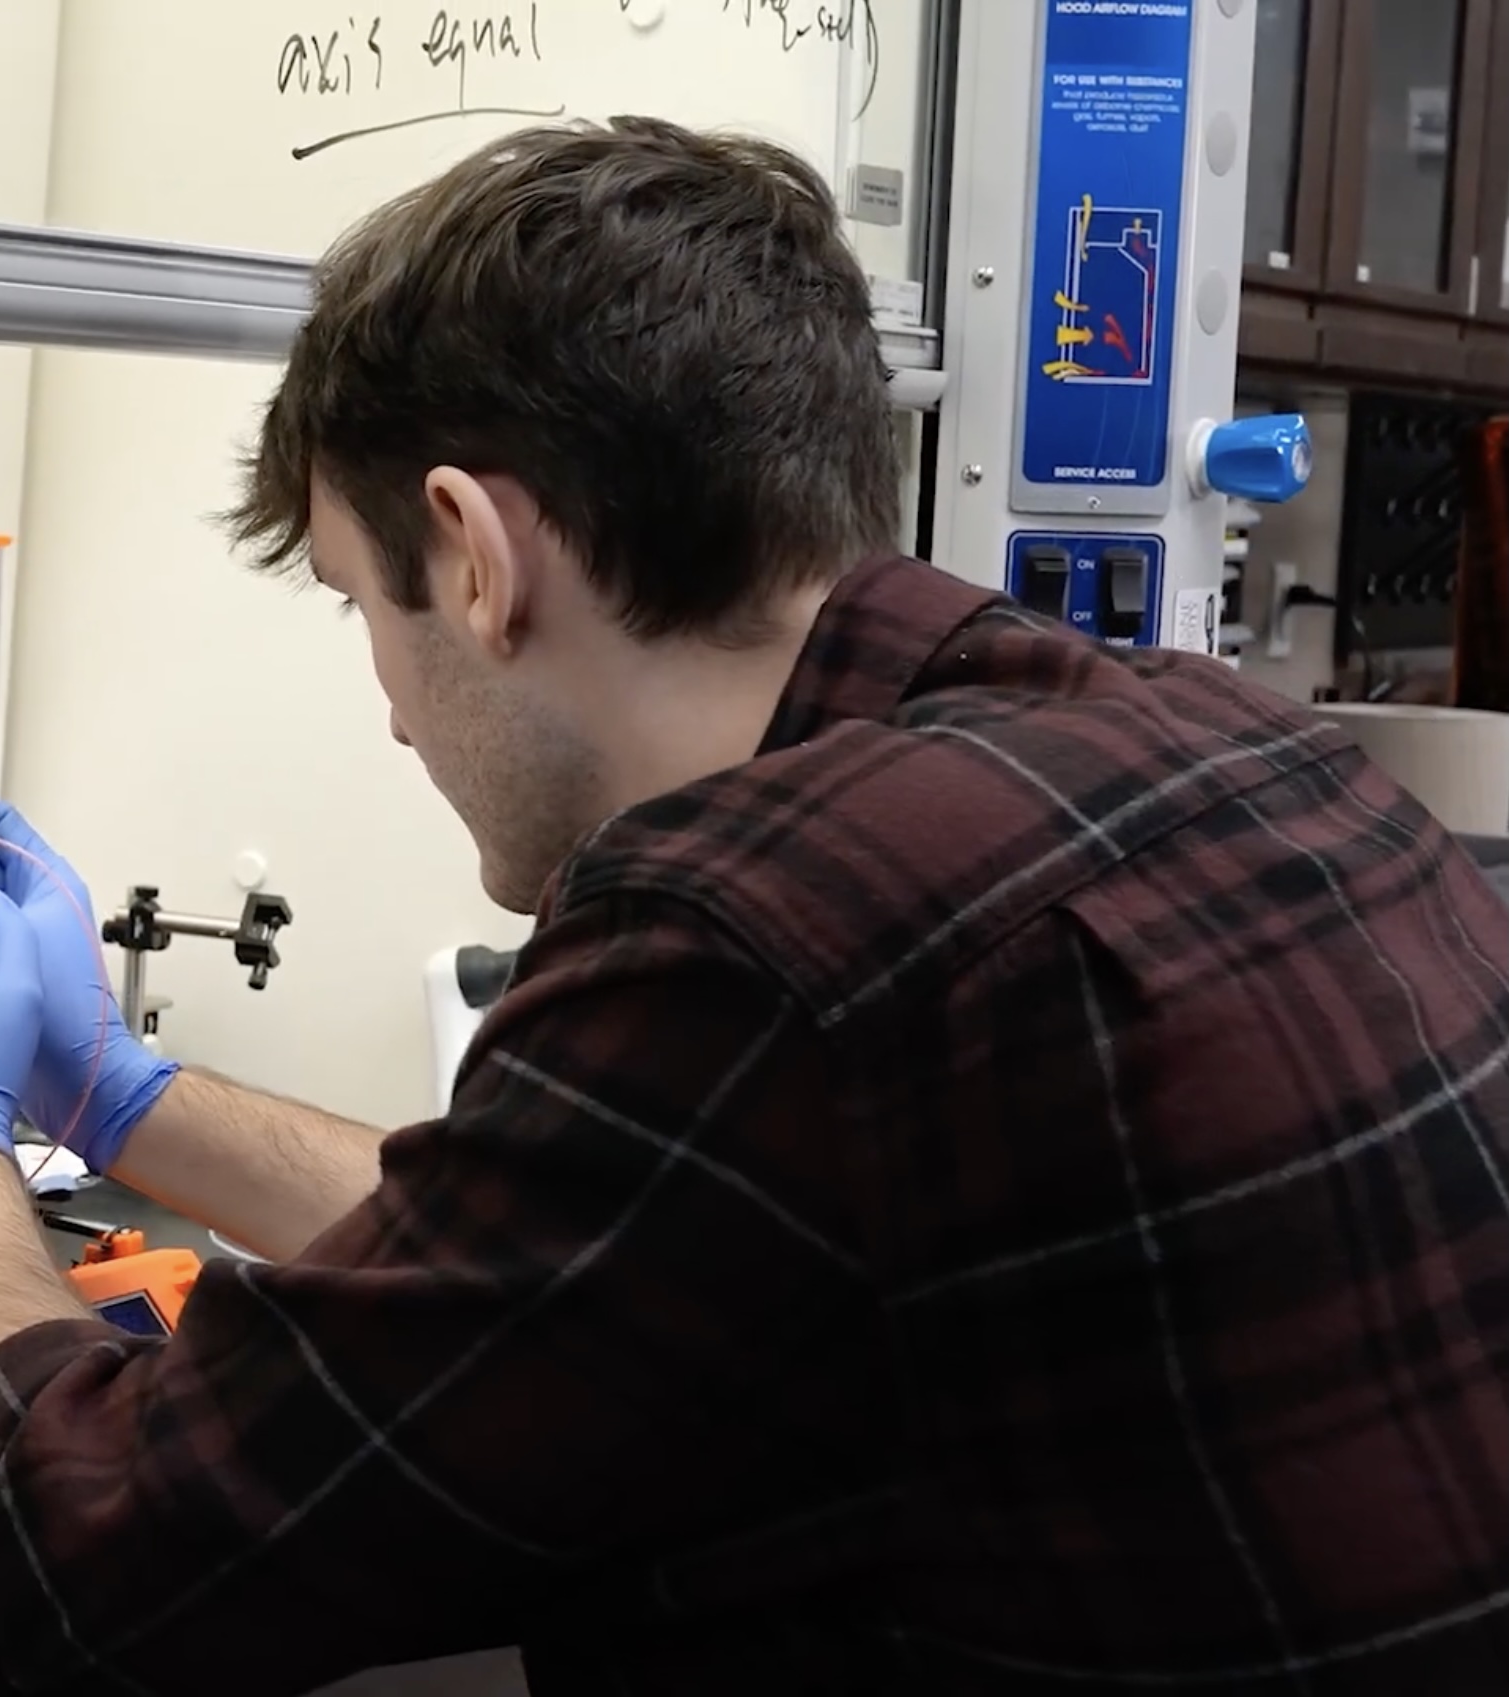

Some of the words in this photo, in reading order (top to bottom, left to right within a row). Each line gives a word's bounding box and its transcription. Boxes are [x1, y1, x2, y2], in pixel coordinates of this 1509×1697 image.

[1055, 2, 1092, 14] HOOD
[277, 17, 382, 95] axis
[422, 2, 541, 112] equal
[1054, 466, 1095, 479] SERVICE
[1097, 467, 1137, 480] ACCESS
[1077, 558, 1095, 570] ON
[1072, 610, 1092, 622] OFF
